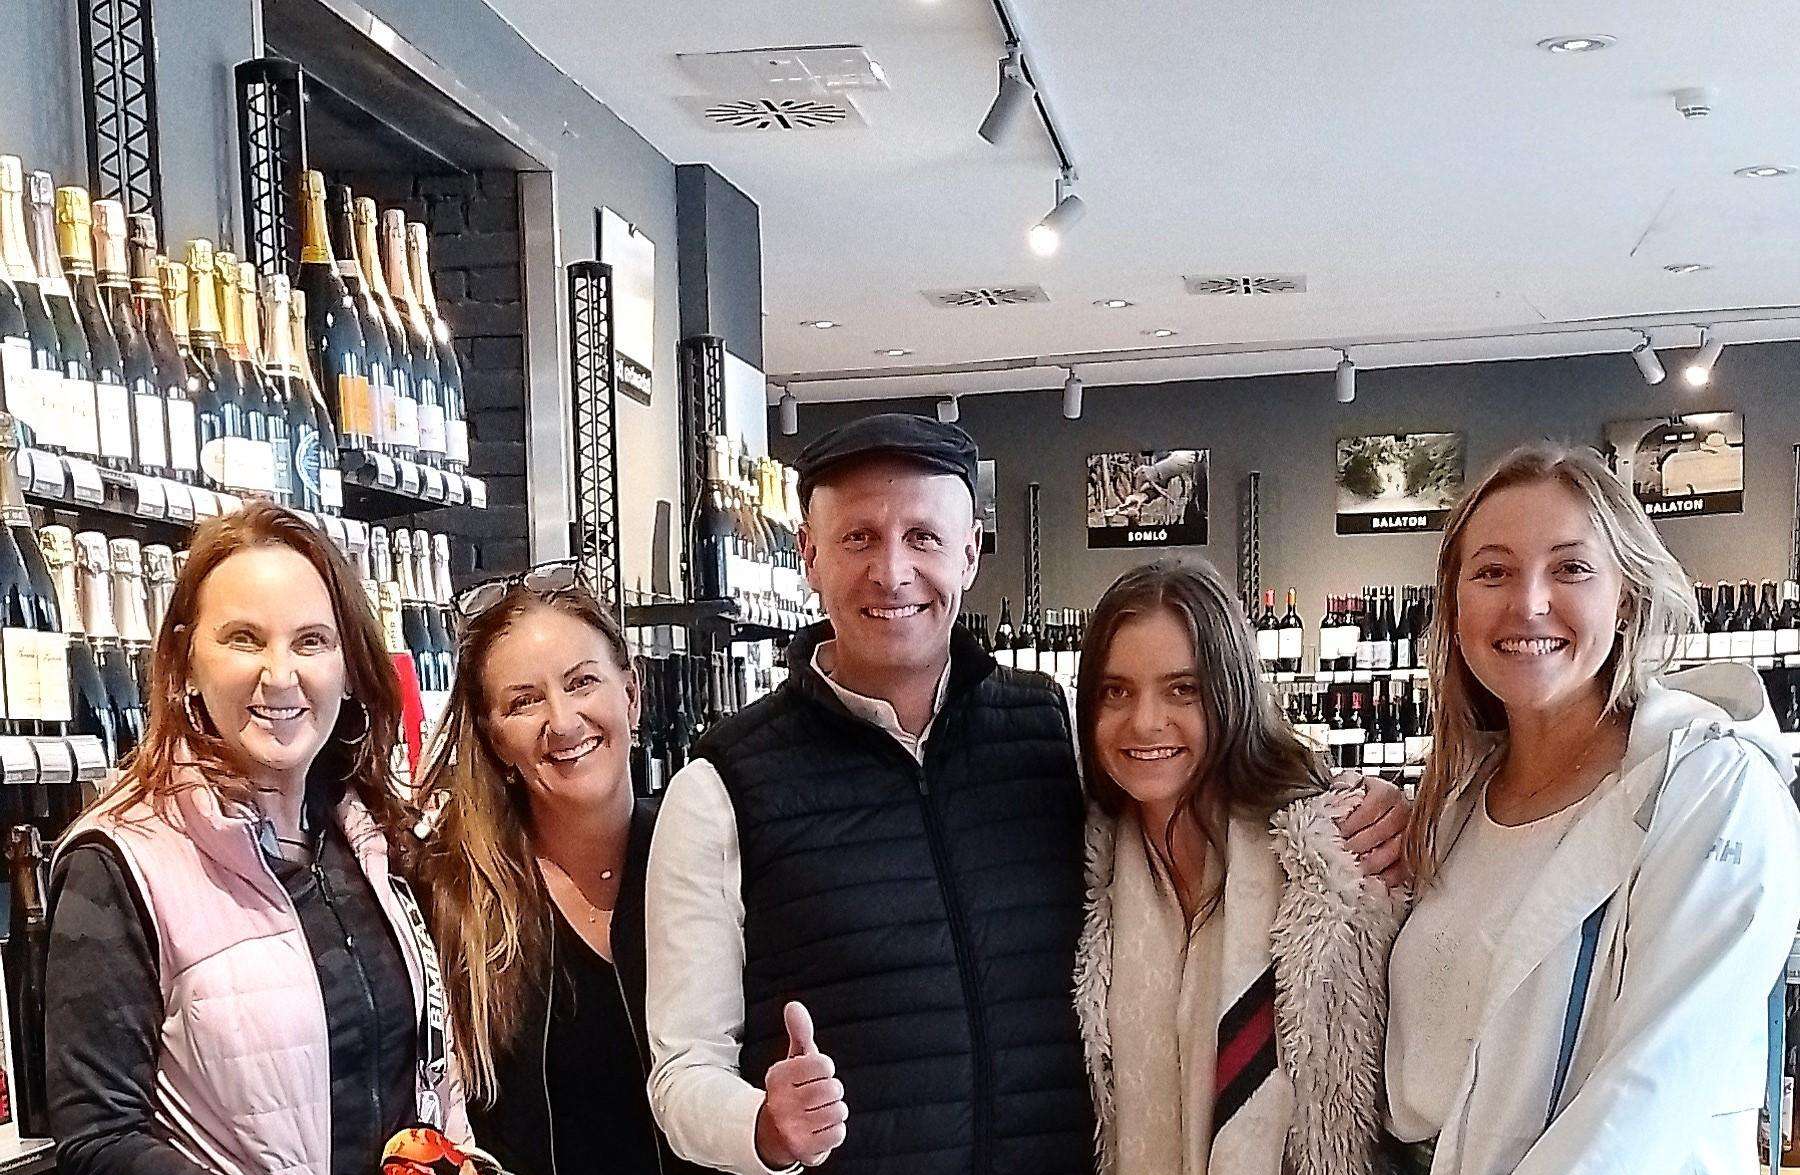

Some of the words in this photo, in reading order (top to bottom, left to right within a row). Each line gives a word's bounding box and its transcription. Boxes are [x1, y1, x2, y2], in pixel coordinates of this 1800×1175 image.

[1645, 499, 1704, 514] BALATON
[1372, 515, 1427, 528] BALATON
[1127, 528, 1168, 542] SOMLÓ
